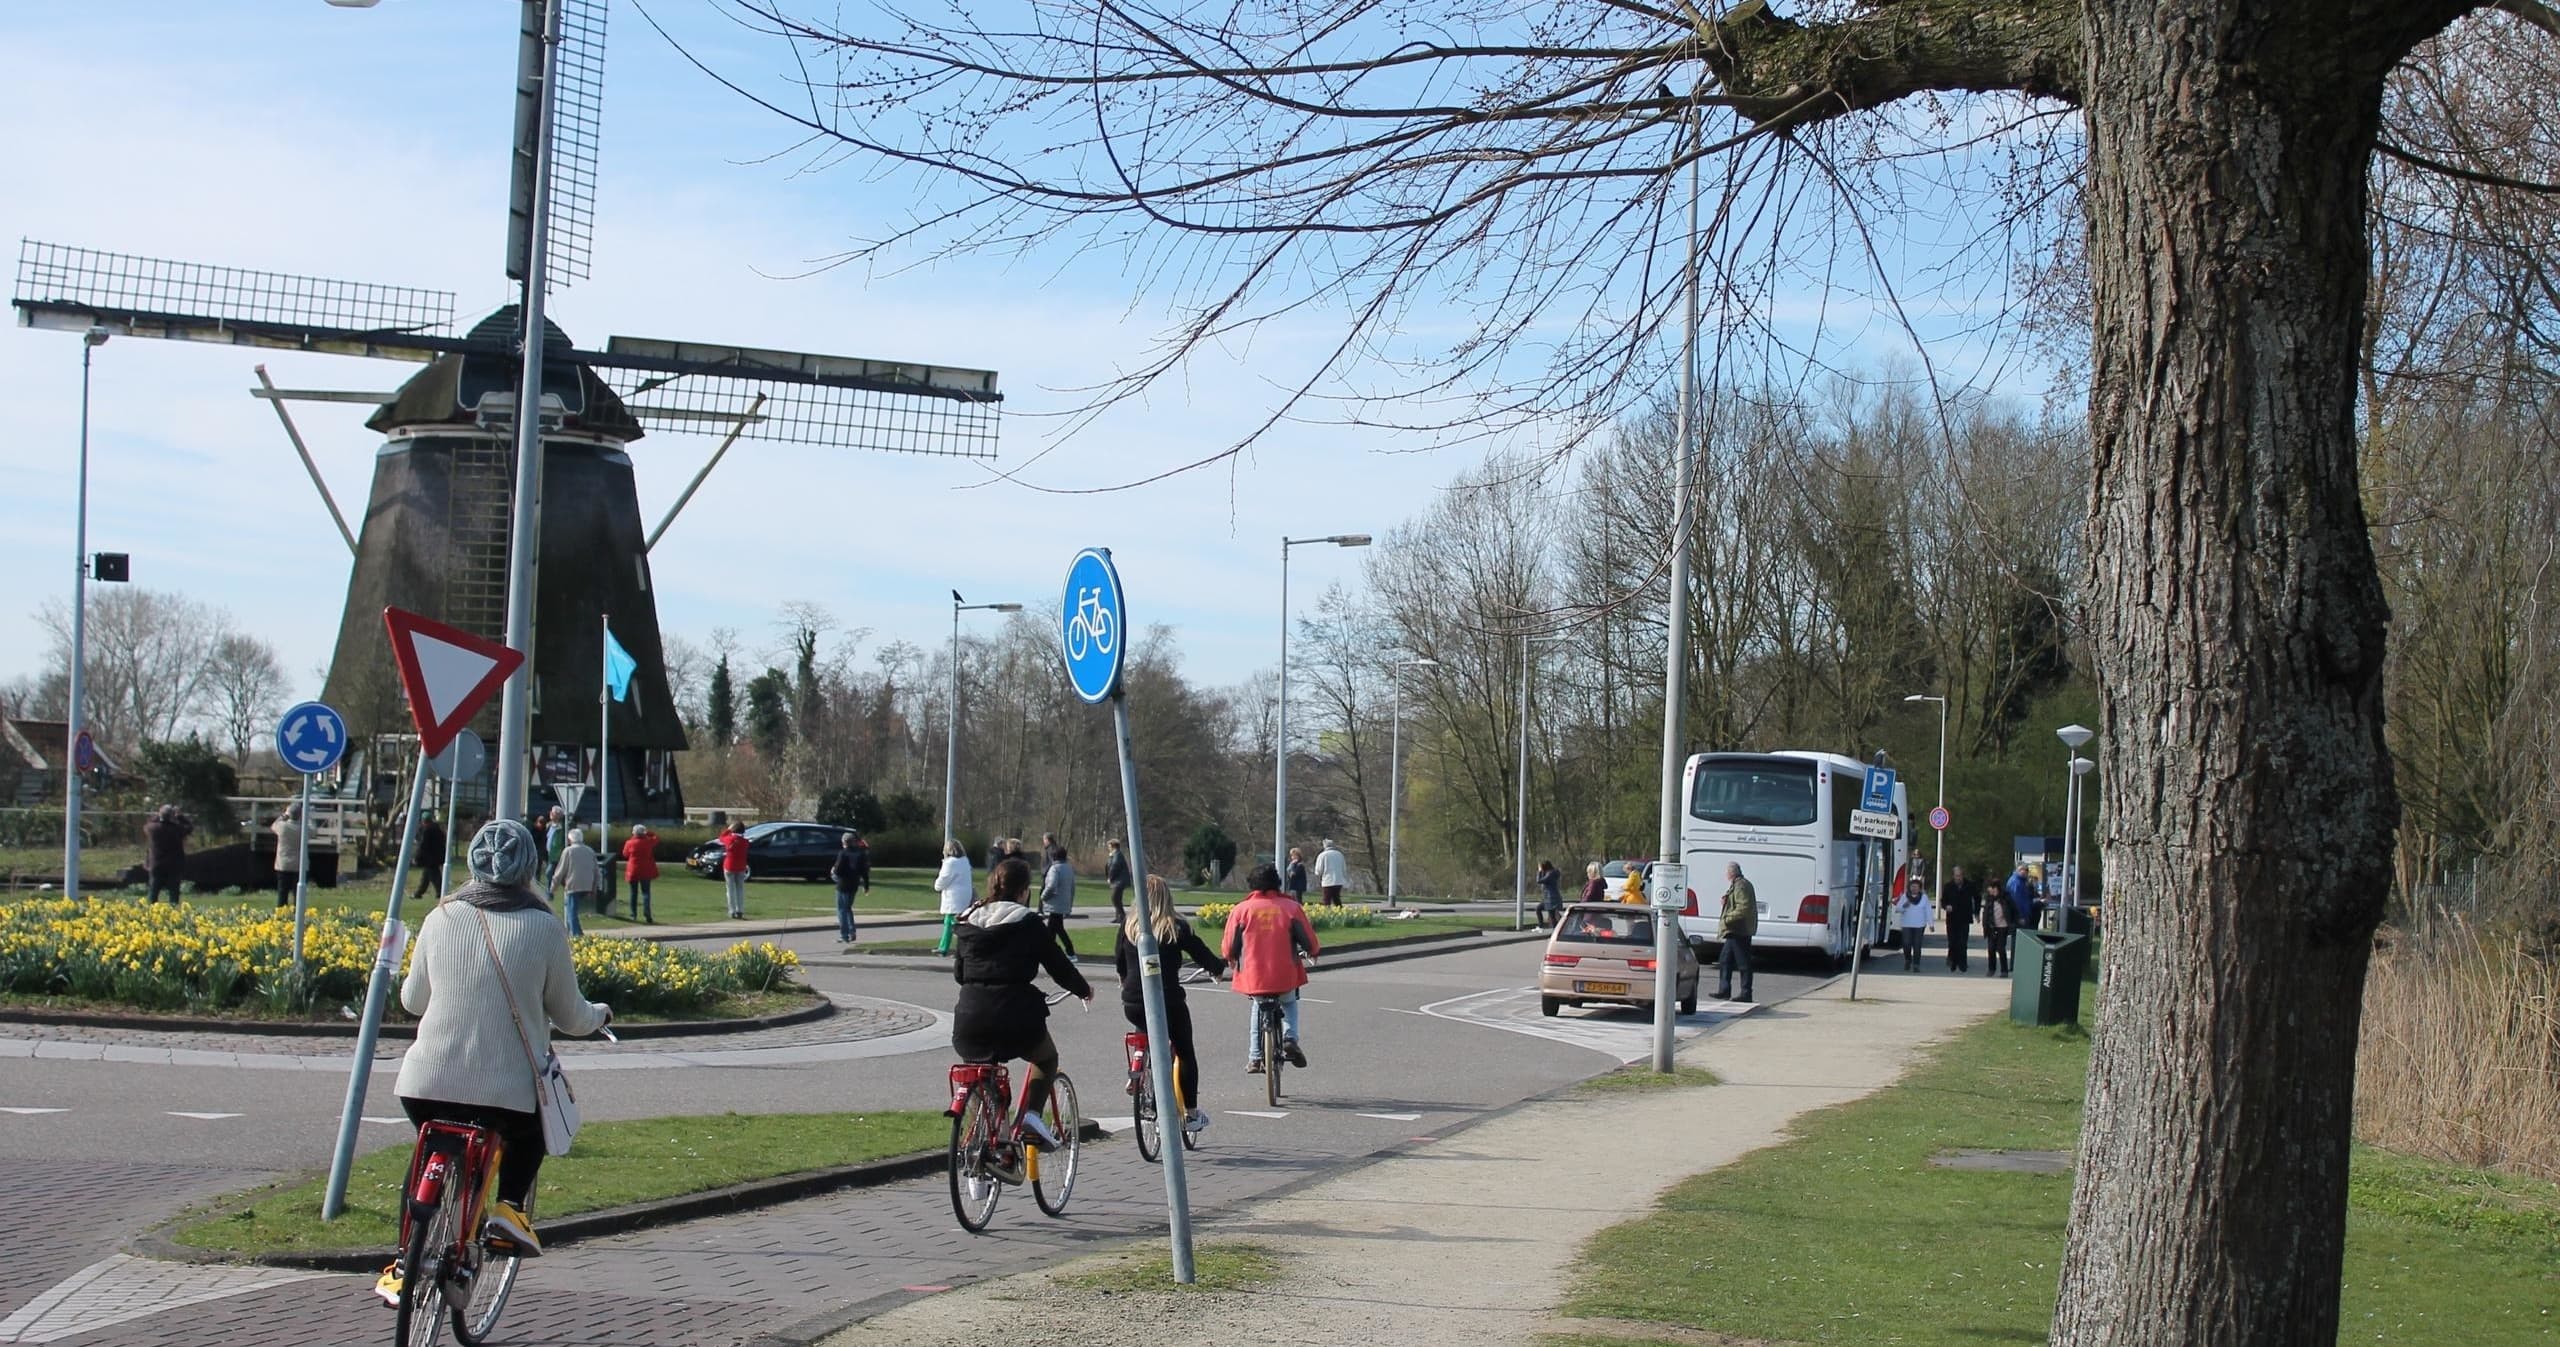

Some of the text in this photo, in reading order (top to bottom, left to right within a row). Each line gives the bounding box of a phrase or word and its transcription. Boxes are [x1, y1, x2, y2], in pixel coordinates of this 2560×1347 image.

[1872, 772, 1888, 793] P
[1853, 815, 1896, 828] bij parkeren
[1853, 825, 1874, 833] motor
[431, 1162, 444, 1173] 14
